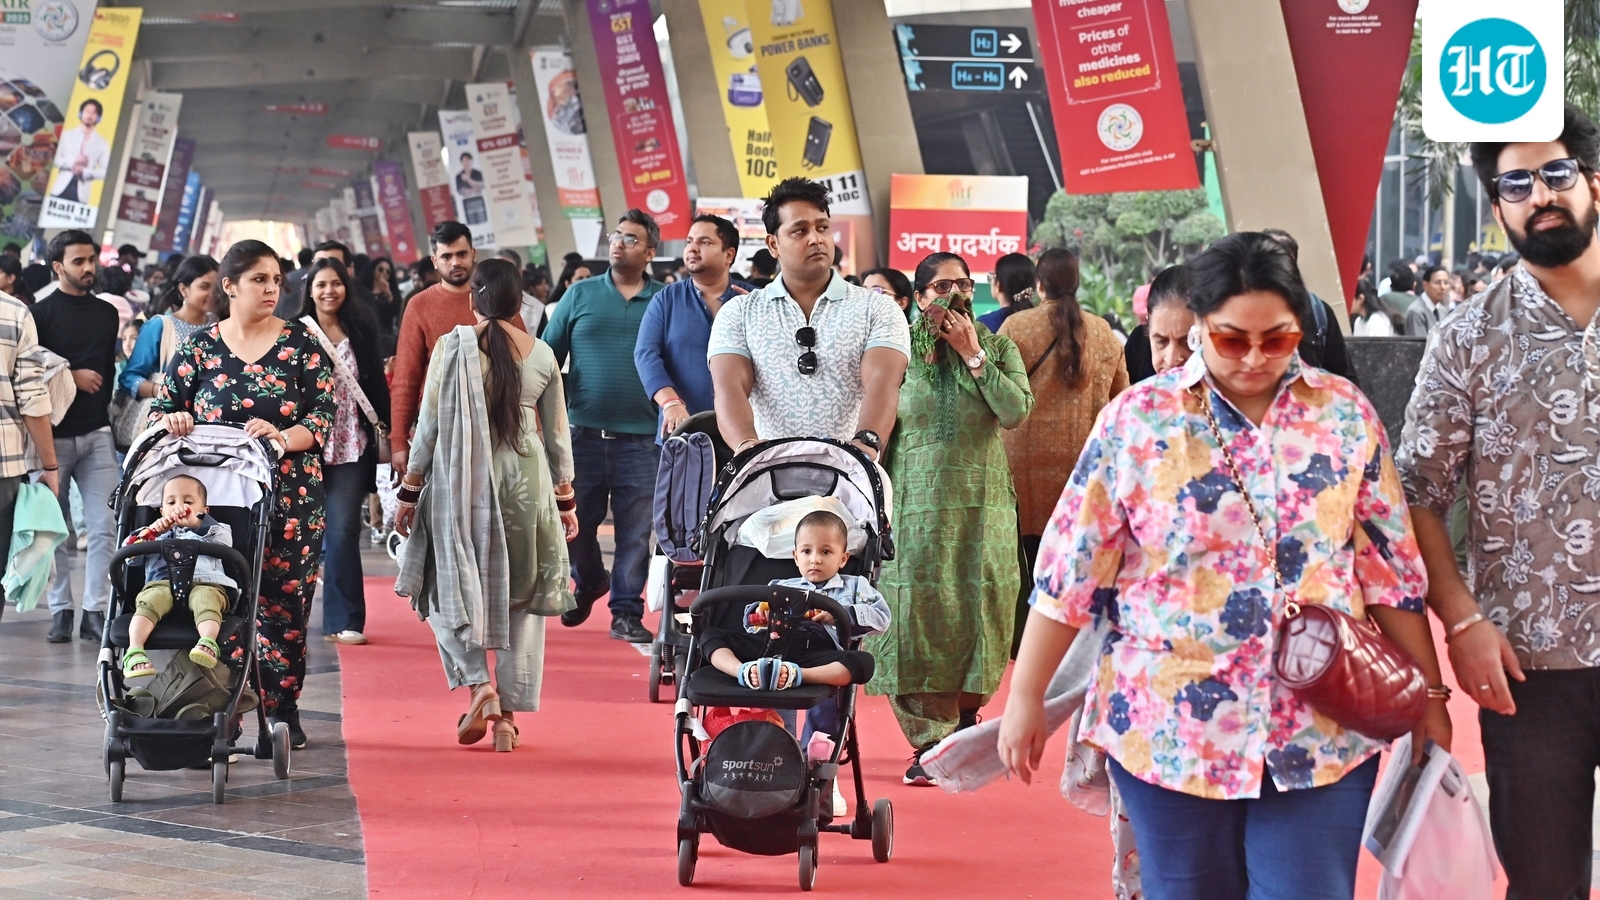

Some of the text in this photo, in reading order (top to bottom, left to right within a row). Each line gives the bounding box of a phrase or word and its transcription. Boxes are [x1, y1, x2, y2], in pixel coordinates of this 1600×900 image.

[1077, 2, 1122, 18] cheaper
[611, 17, 632, 32] GST
[1079, 24, 1130, 43] Prices of
[761, 33, 830, 57] POWER BANKS
[976, 38, 991, 49] H2
[1091, 42, 1123, 56] other
[1079, 53, 1141, 73] medicines
[957, 70, 973, 82] H4
[1074, 64, 1151, 88] also reduced
[747, 130, 771, 143] Hall
[746, 143, 774, 157] Boot
[1124, 152, 1141, 160] details
[746, 158, 777, 178] 10C
[1095, 164, 1117, 173] Customs
[1117, 160, 1138, 168] Pavilion
[838, 174, 857, 190] 11
[836, 190, 860, 203] 10C
[49, 201, 90, 216] Hall 11
[897, 227, 1021, 257] अन्य प्रदर्शक
[722, 758, 775, 773] sportsun
